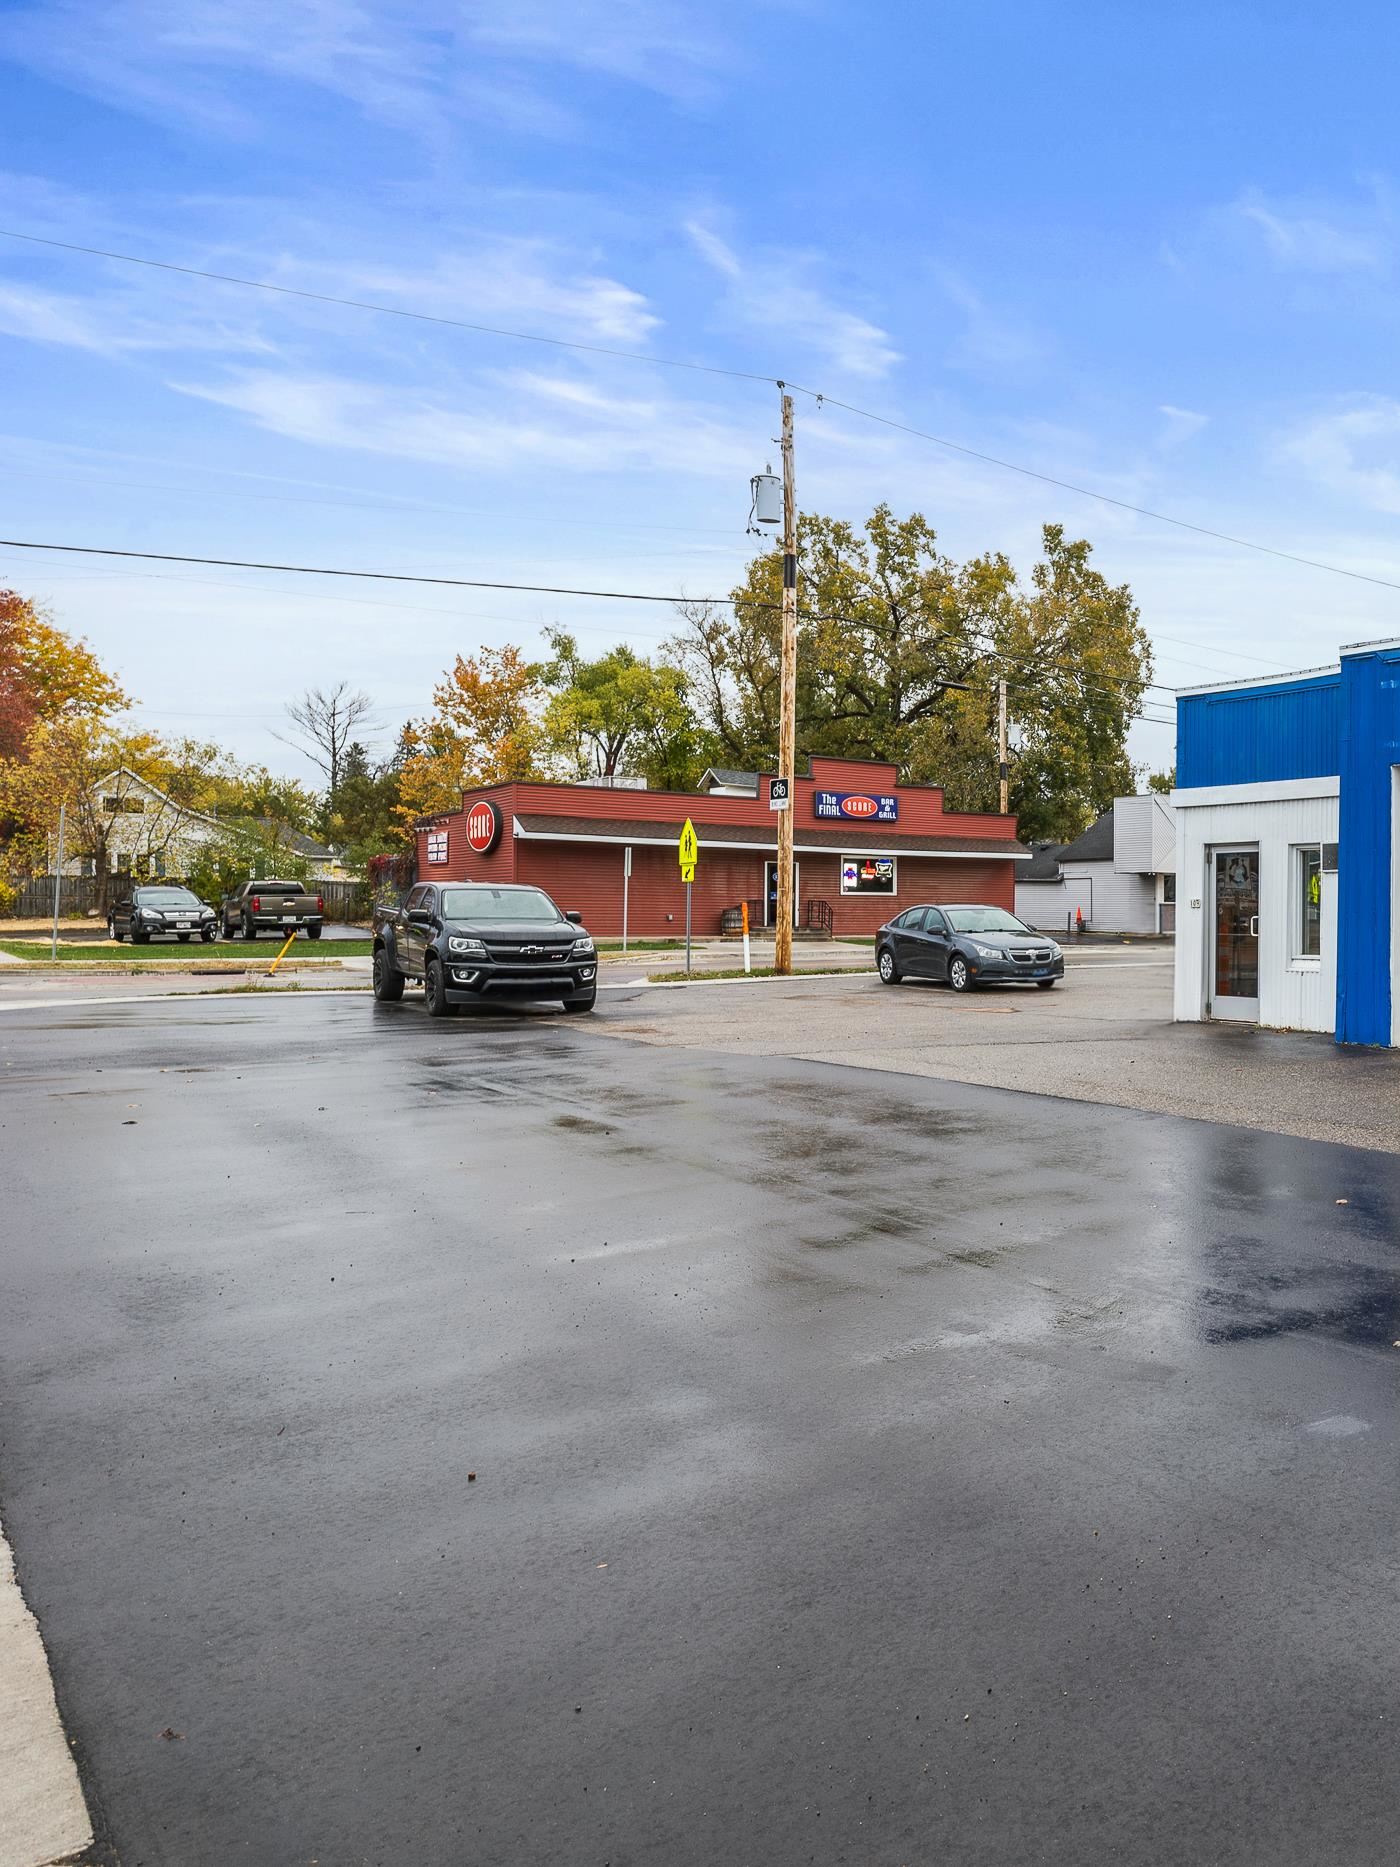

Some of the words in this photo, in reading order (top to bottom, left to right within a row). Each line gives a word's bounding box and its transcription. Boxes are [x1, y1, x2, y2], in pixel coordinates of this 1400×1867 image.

[822, 794, 836, 804] The
[819, 805, 840, 815] FINAL
[847, 801, 872, 812] SCORE
